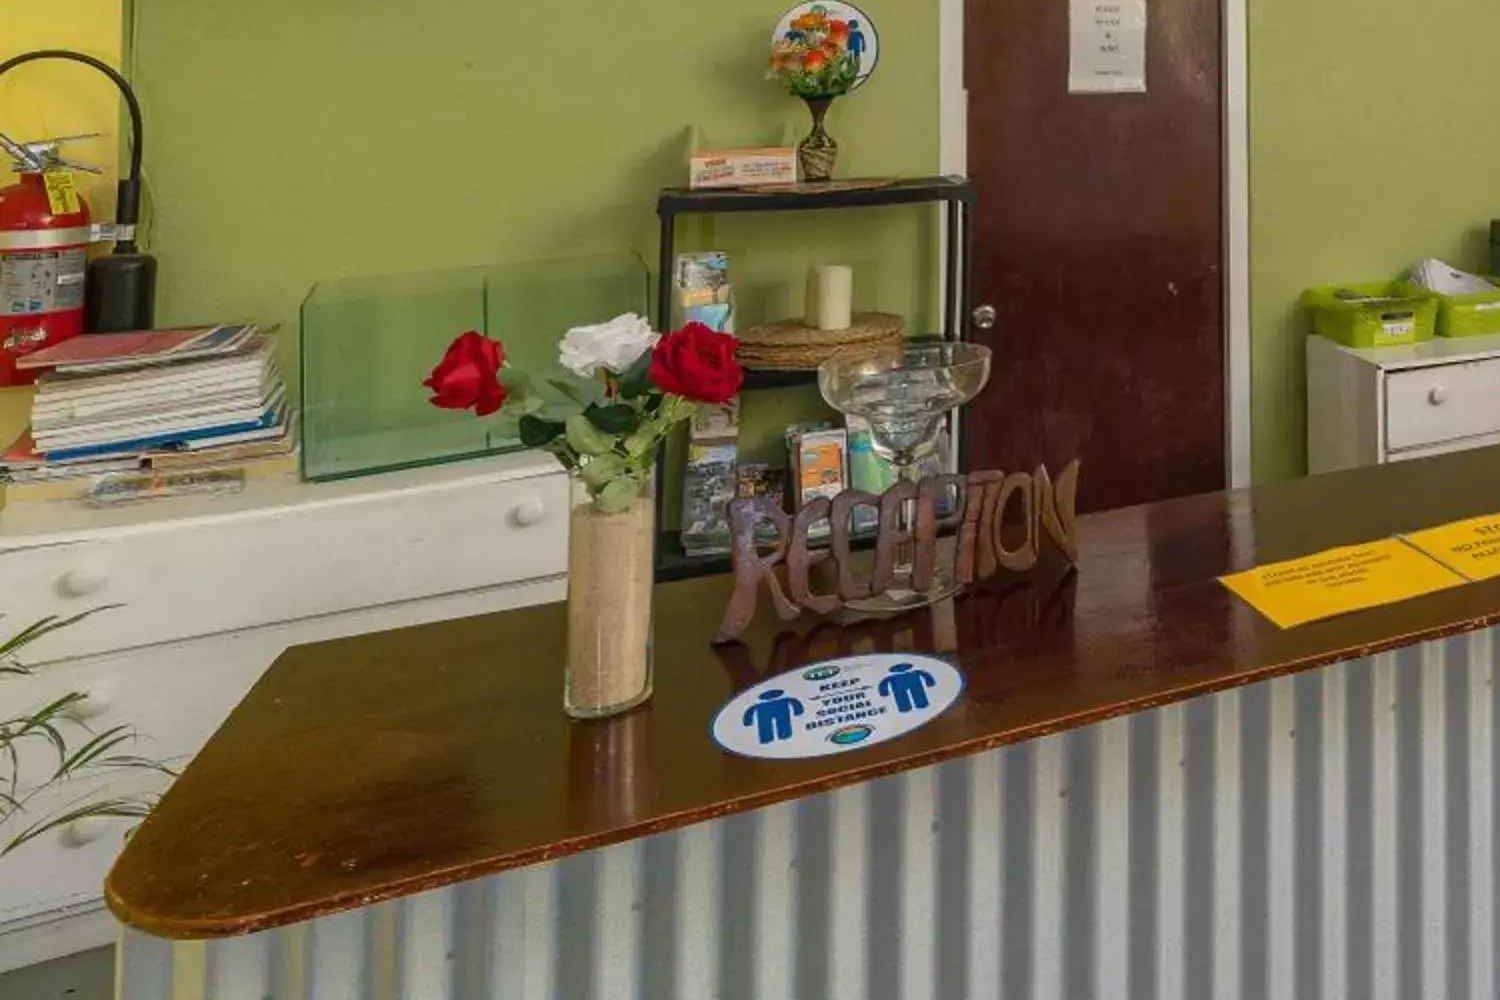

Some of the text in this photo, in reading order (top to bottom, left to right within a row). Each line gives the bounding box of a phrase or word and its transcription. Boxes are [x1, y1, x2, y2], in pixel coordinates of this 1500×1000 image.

[711, 459, 1080, 644] RECEPTION
[819, 677, 861, 692] KEEP
[815, 699, 872, 717] SOCIAL
[822, 691, 866, 707] YOUR
[804, 705, 887, 731] DISTANCE
